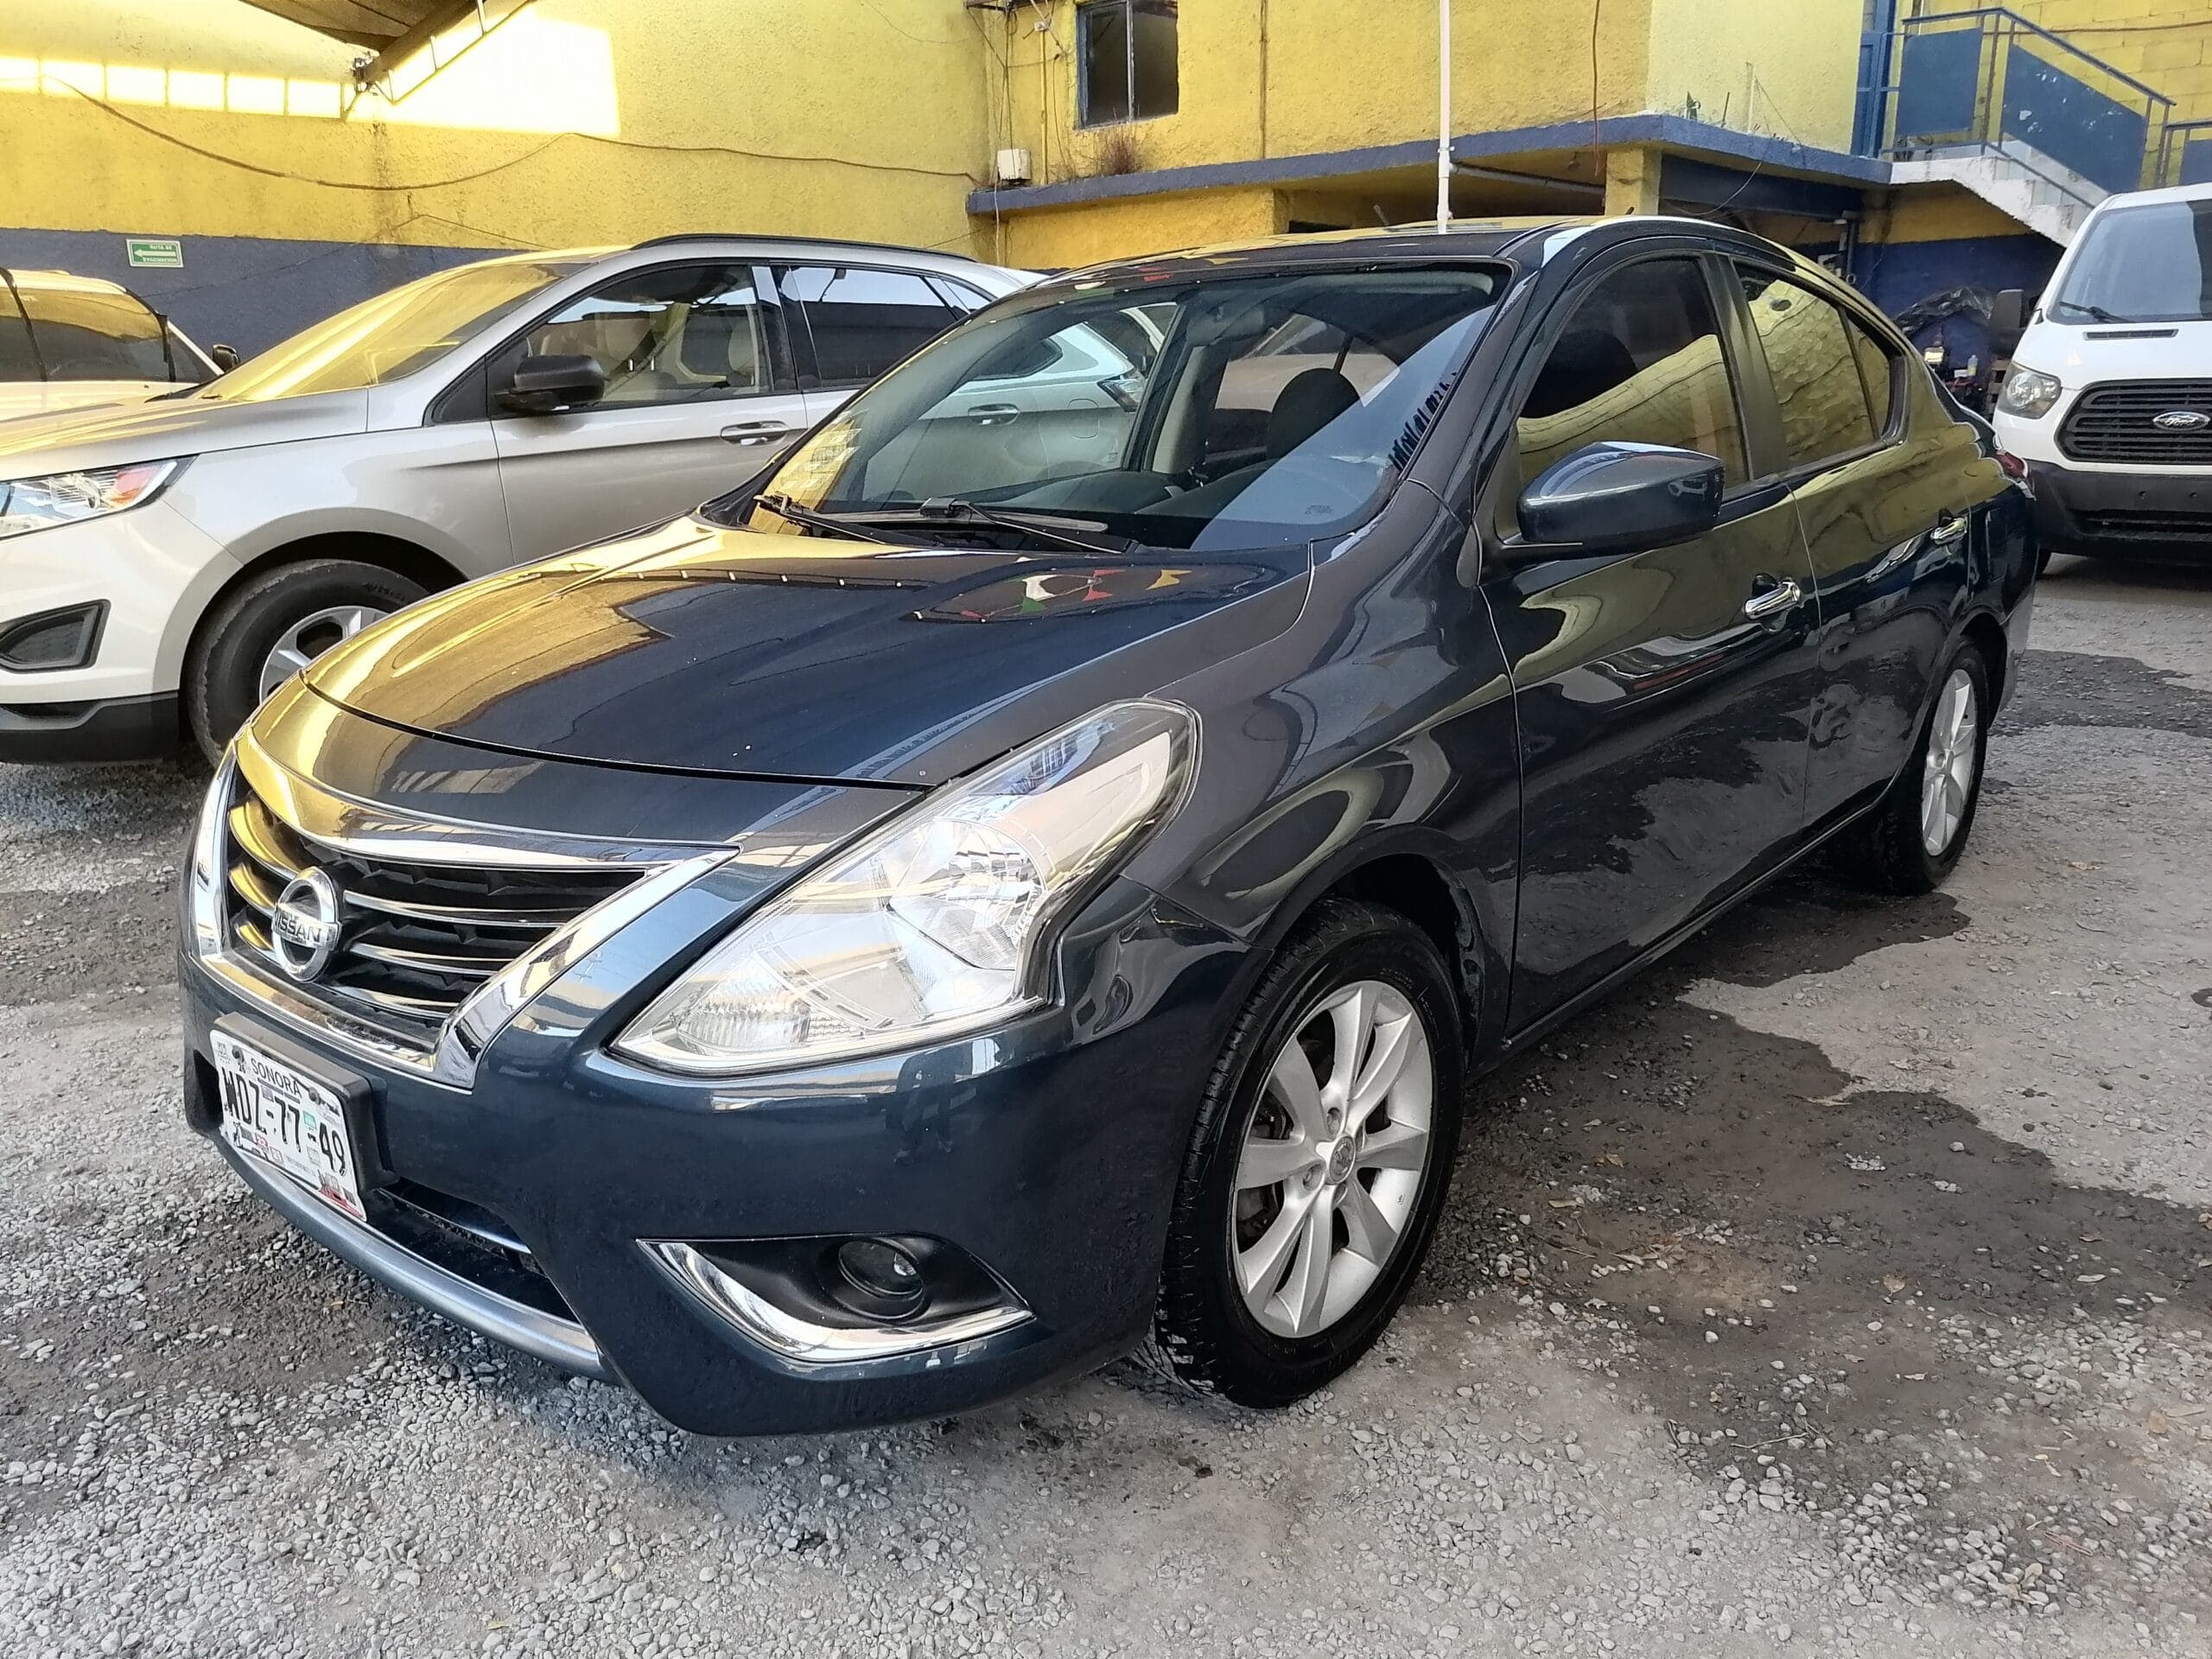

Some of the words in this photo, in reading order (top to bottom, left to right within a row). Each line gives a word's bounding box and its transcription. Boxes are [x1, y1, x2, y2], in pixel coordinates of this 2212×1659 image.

[2164, 414, 2199, 427] Ford
[274, 913, 322, 943] NISSAN
[250, 1057, 302, 1099] SONORA
